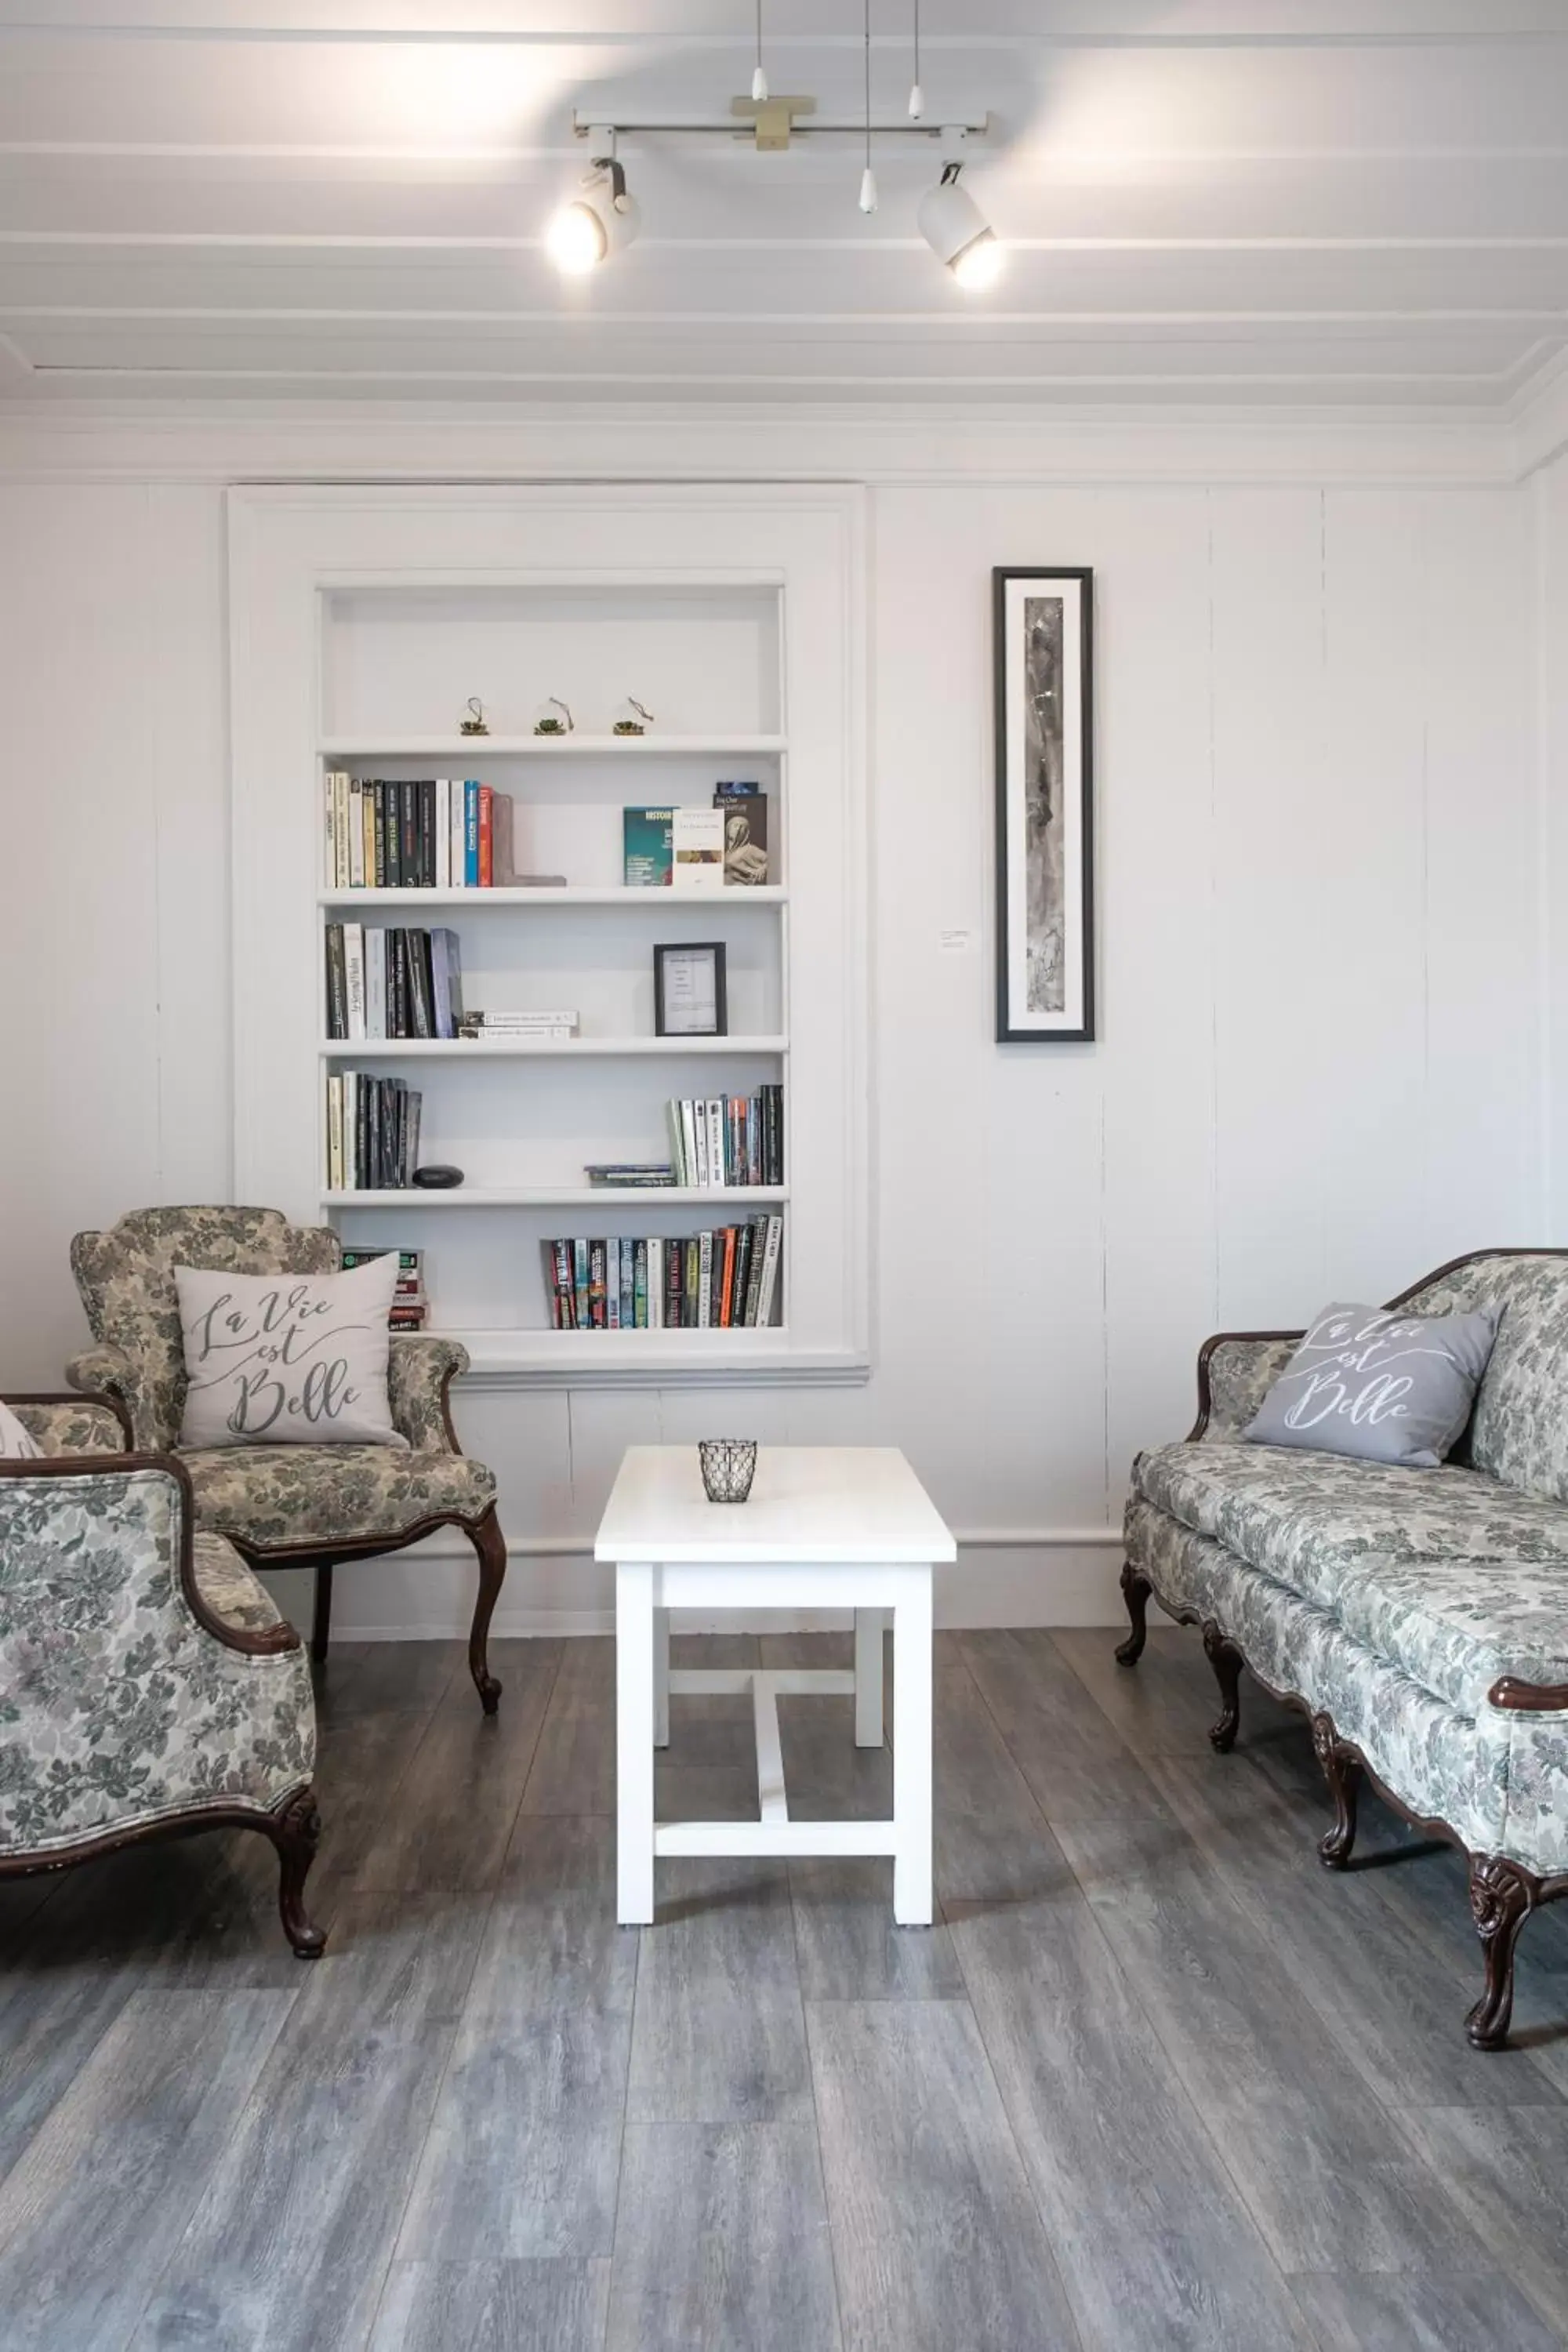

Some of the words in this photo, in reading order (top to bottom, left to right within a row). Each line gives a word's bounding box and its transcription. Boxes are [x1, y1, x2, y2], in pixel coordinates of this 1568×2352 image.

[191, 1294, 260, 1363] La
[258, 1285, 333, 1333] Vie
[1294, 1311, 1355, 1358] La
[227, 1359, 361, 1434] Belle
[1284, 1371, 1414, 1429] Belle
